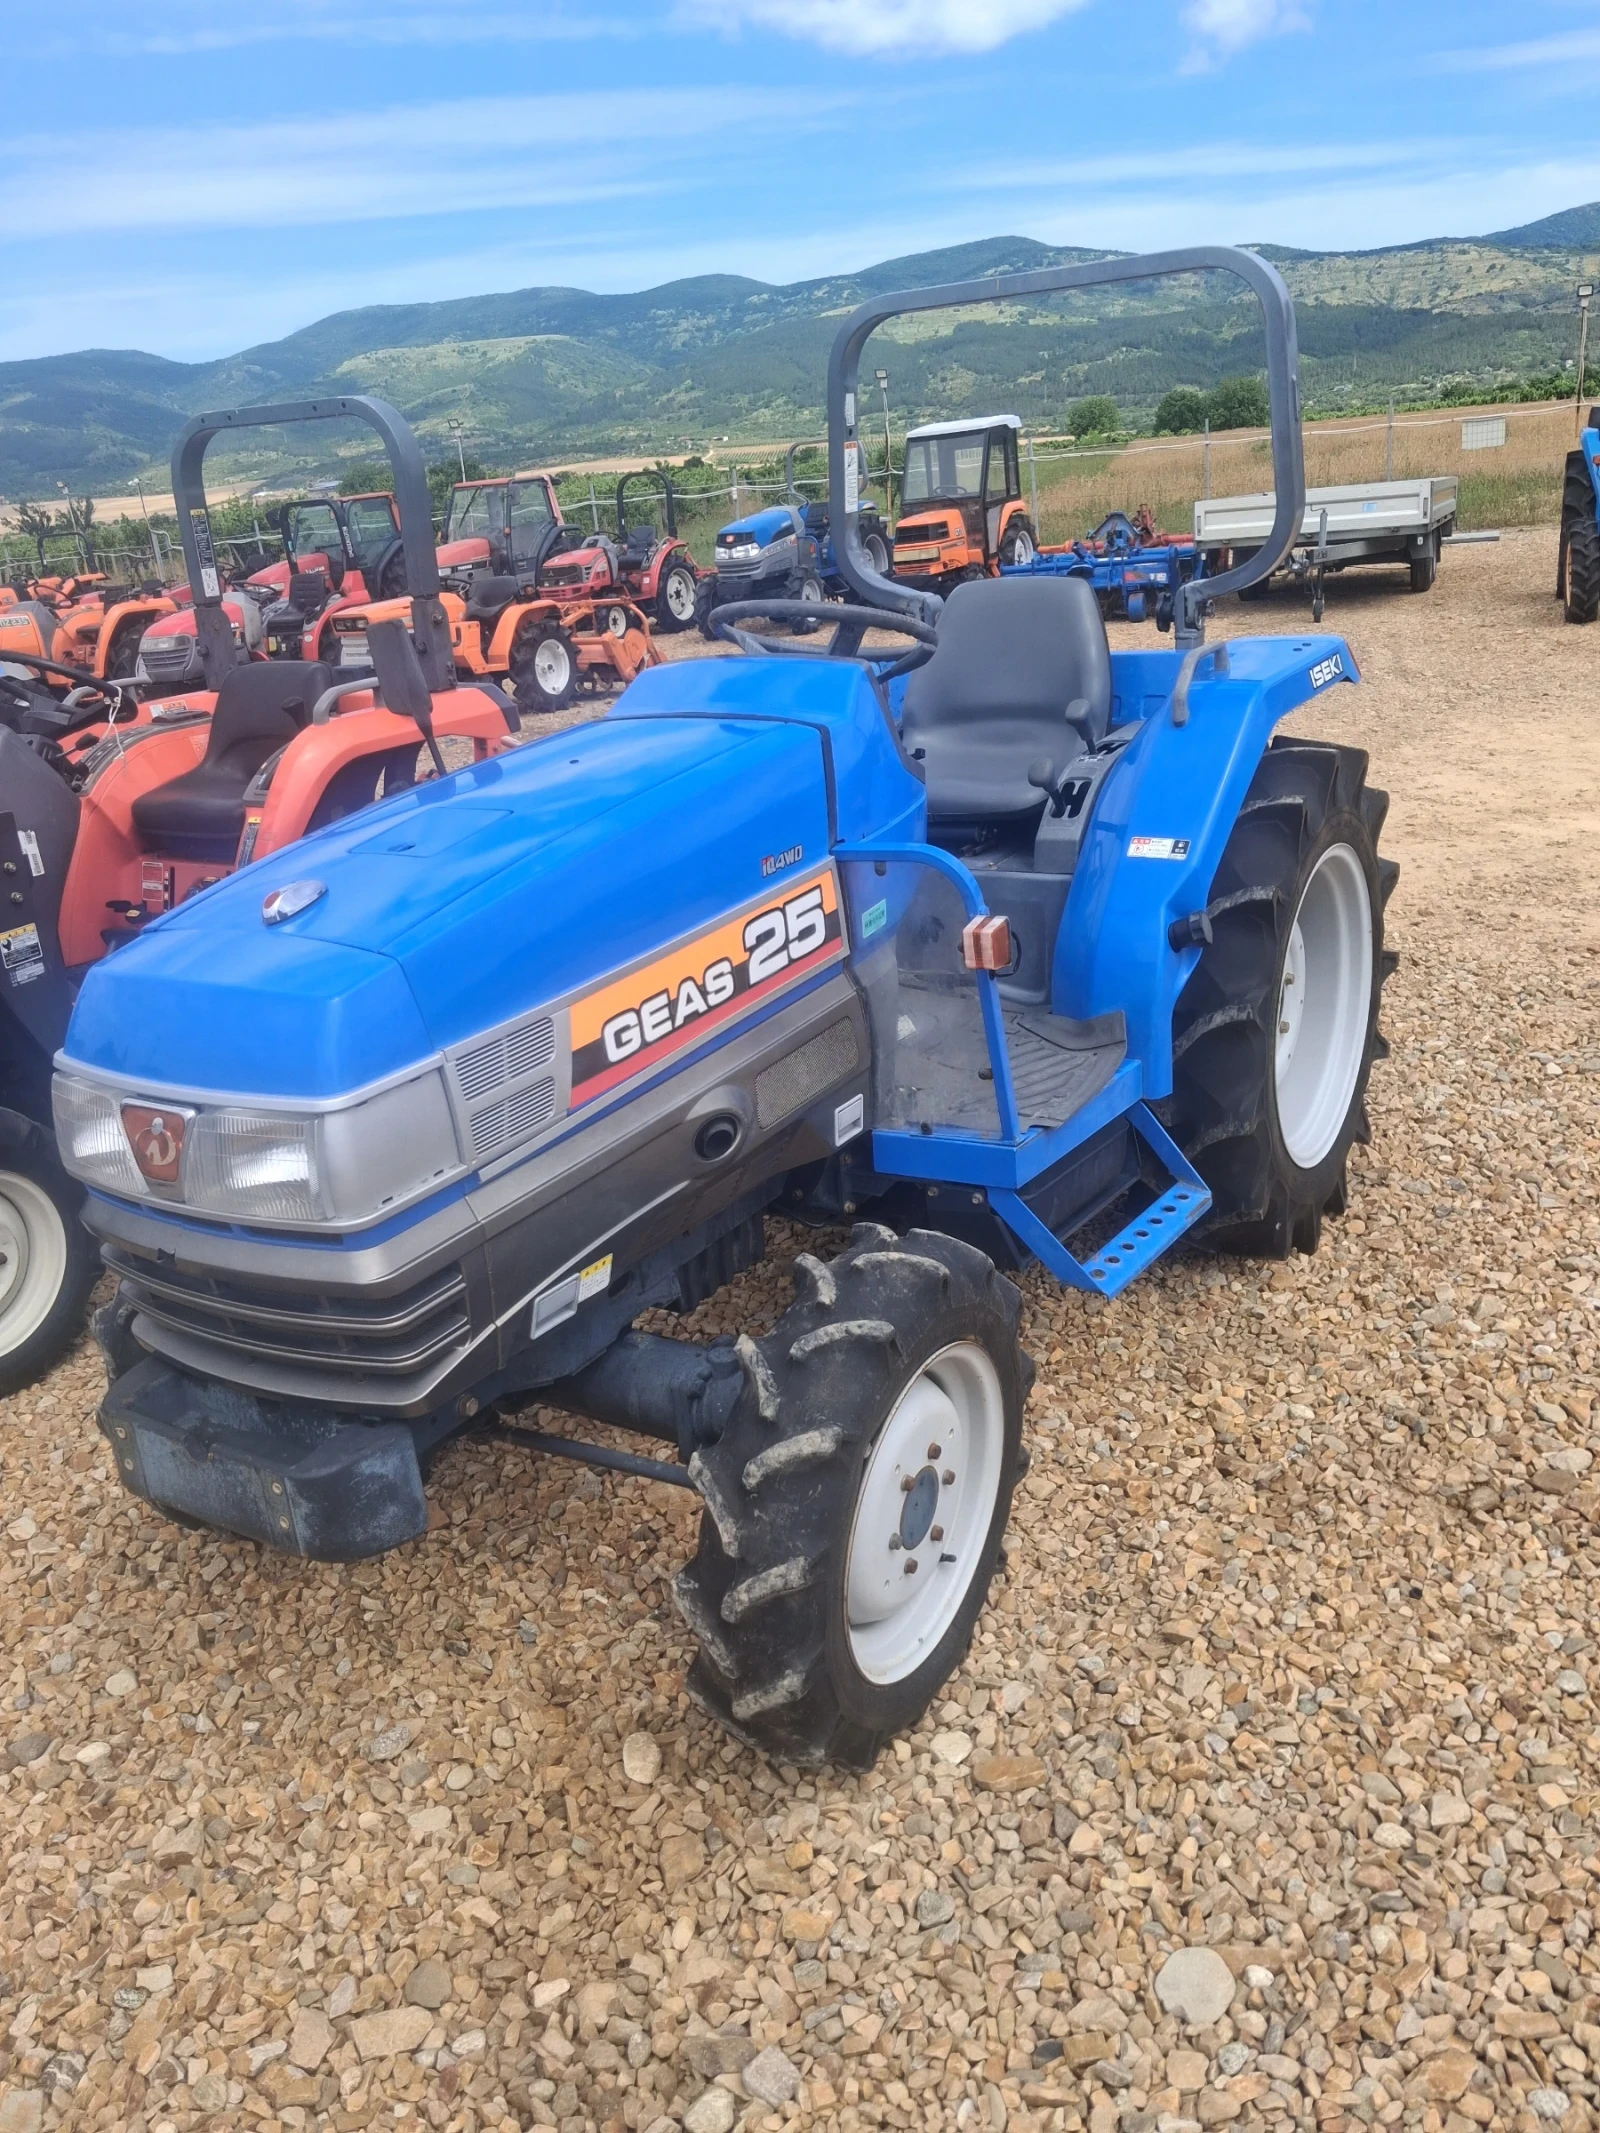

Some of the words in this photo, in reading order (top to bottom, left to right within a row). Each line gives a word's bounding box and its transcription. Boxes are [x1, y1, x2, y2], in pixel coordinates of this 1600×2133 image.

[1309, 653, 1343, 689] ISEKI
[602, 957, 735, 1064] GEAS
[743, 885, 826, 987] 25
